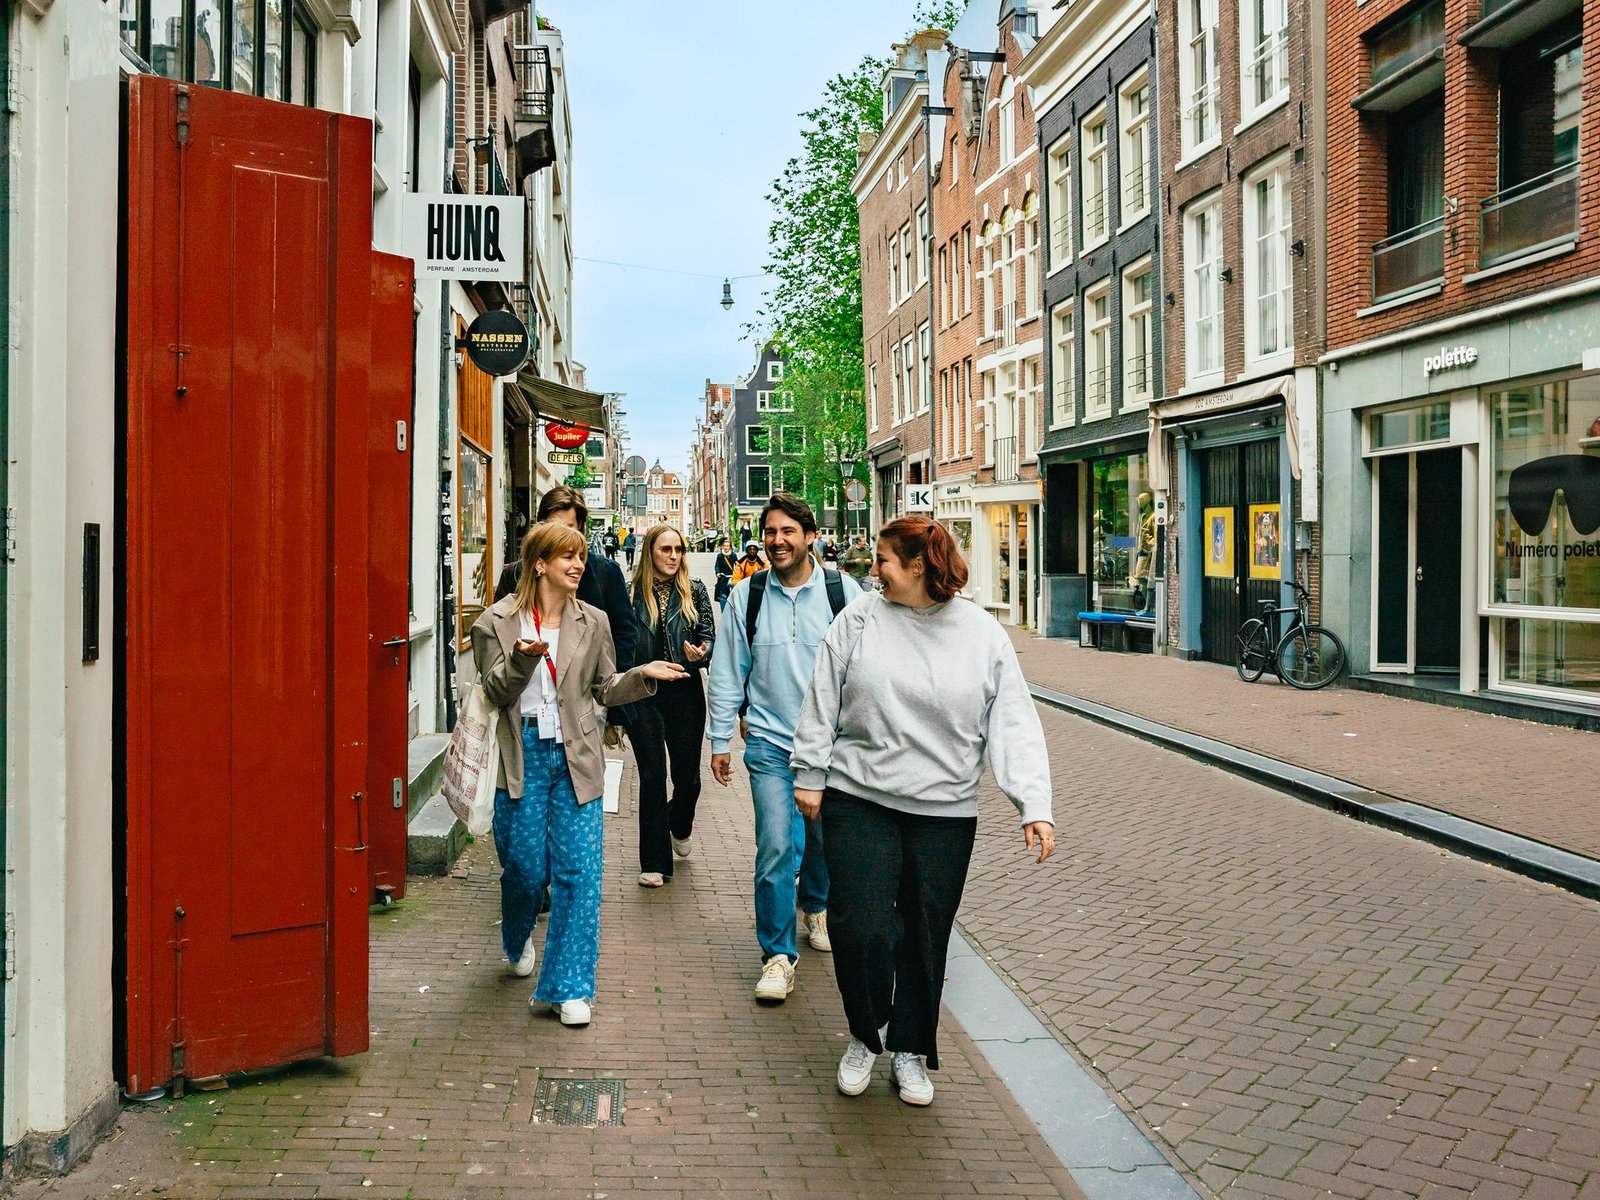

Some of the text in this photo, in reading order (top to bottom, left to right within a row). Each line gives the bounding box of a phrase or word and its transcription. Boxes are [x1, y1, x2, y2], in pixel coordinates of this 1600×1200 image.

[427, 203, 505, 262] HUNQ
[471, 333, 523, 343] NASSEN
[1424, 345, 1478, 377] polette
[1205, 393, 1234, 405] AMSTERDAM
[554, 432, 582, 441] Jupiler
[550, 453, 582, 463] DE PELS
[1505, 541, 1558, 558] Numéro
